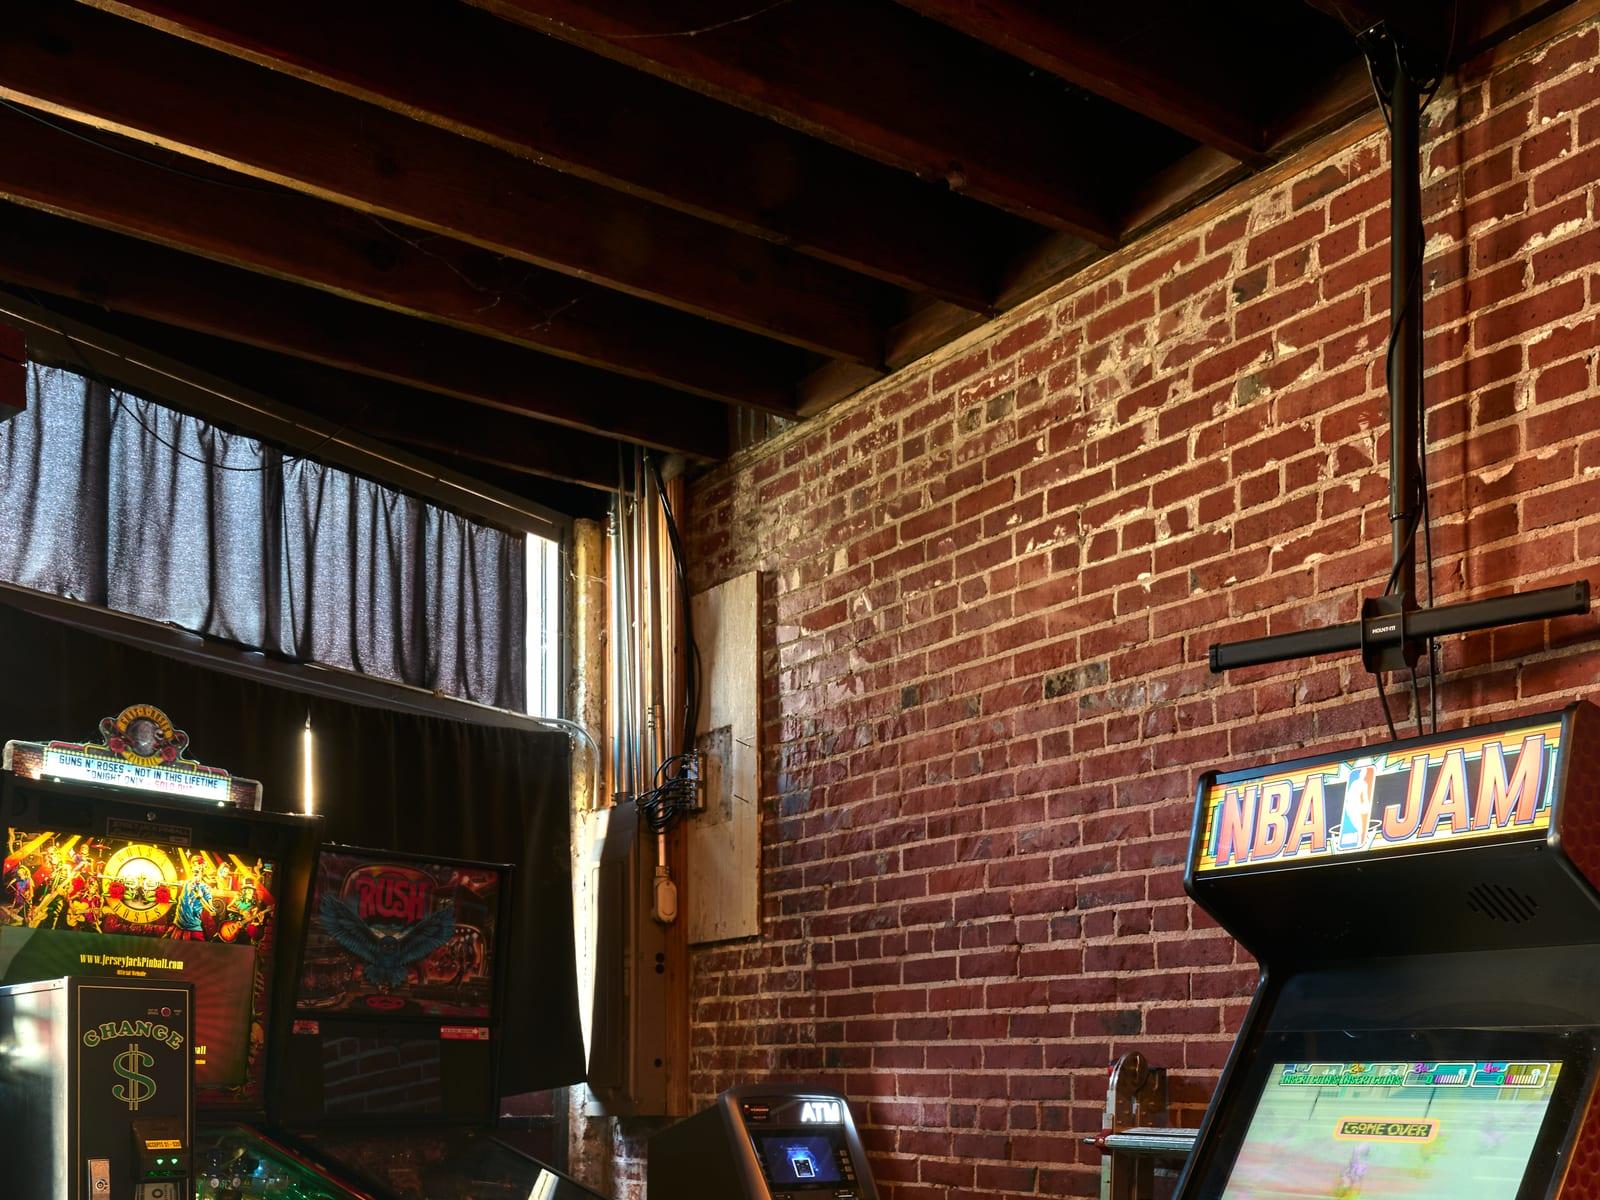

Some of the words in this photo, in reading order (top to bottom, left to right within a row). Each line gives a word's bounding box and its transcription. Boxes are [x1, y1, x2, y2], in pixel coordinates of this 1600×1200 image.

[59, 754, 82, 767] GUNS
[97, 760, 124, 774] ROSES
[135, 767, 151, 778] NOT
[154, 770, 162, 780] IN
[165, 772, 183, 783] THIS
[184, 775, 218, 789] LIFETIME
[1214, 773, 1327, 867] NBA
[1381, 733, 1545, 843] JAM
[357, 876, 430, 926] RUSH
[83, 1020, 184, 1050] CHANGE
[112, 1043, 157, 1110] $
[801, 1102, 841, 1122] ATM
[1344, 1122, 1386, 1135] GAME
[1387, 1124, 1427, 1137] OVER
